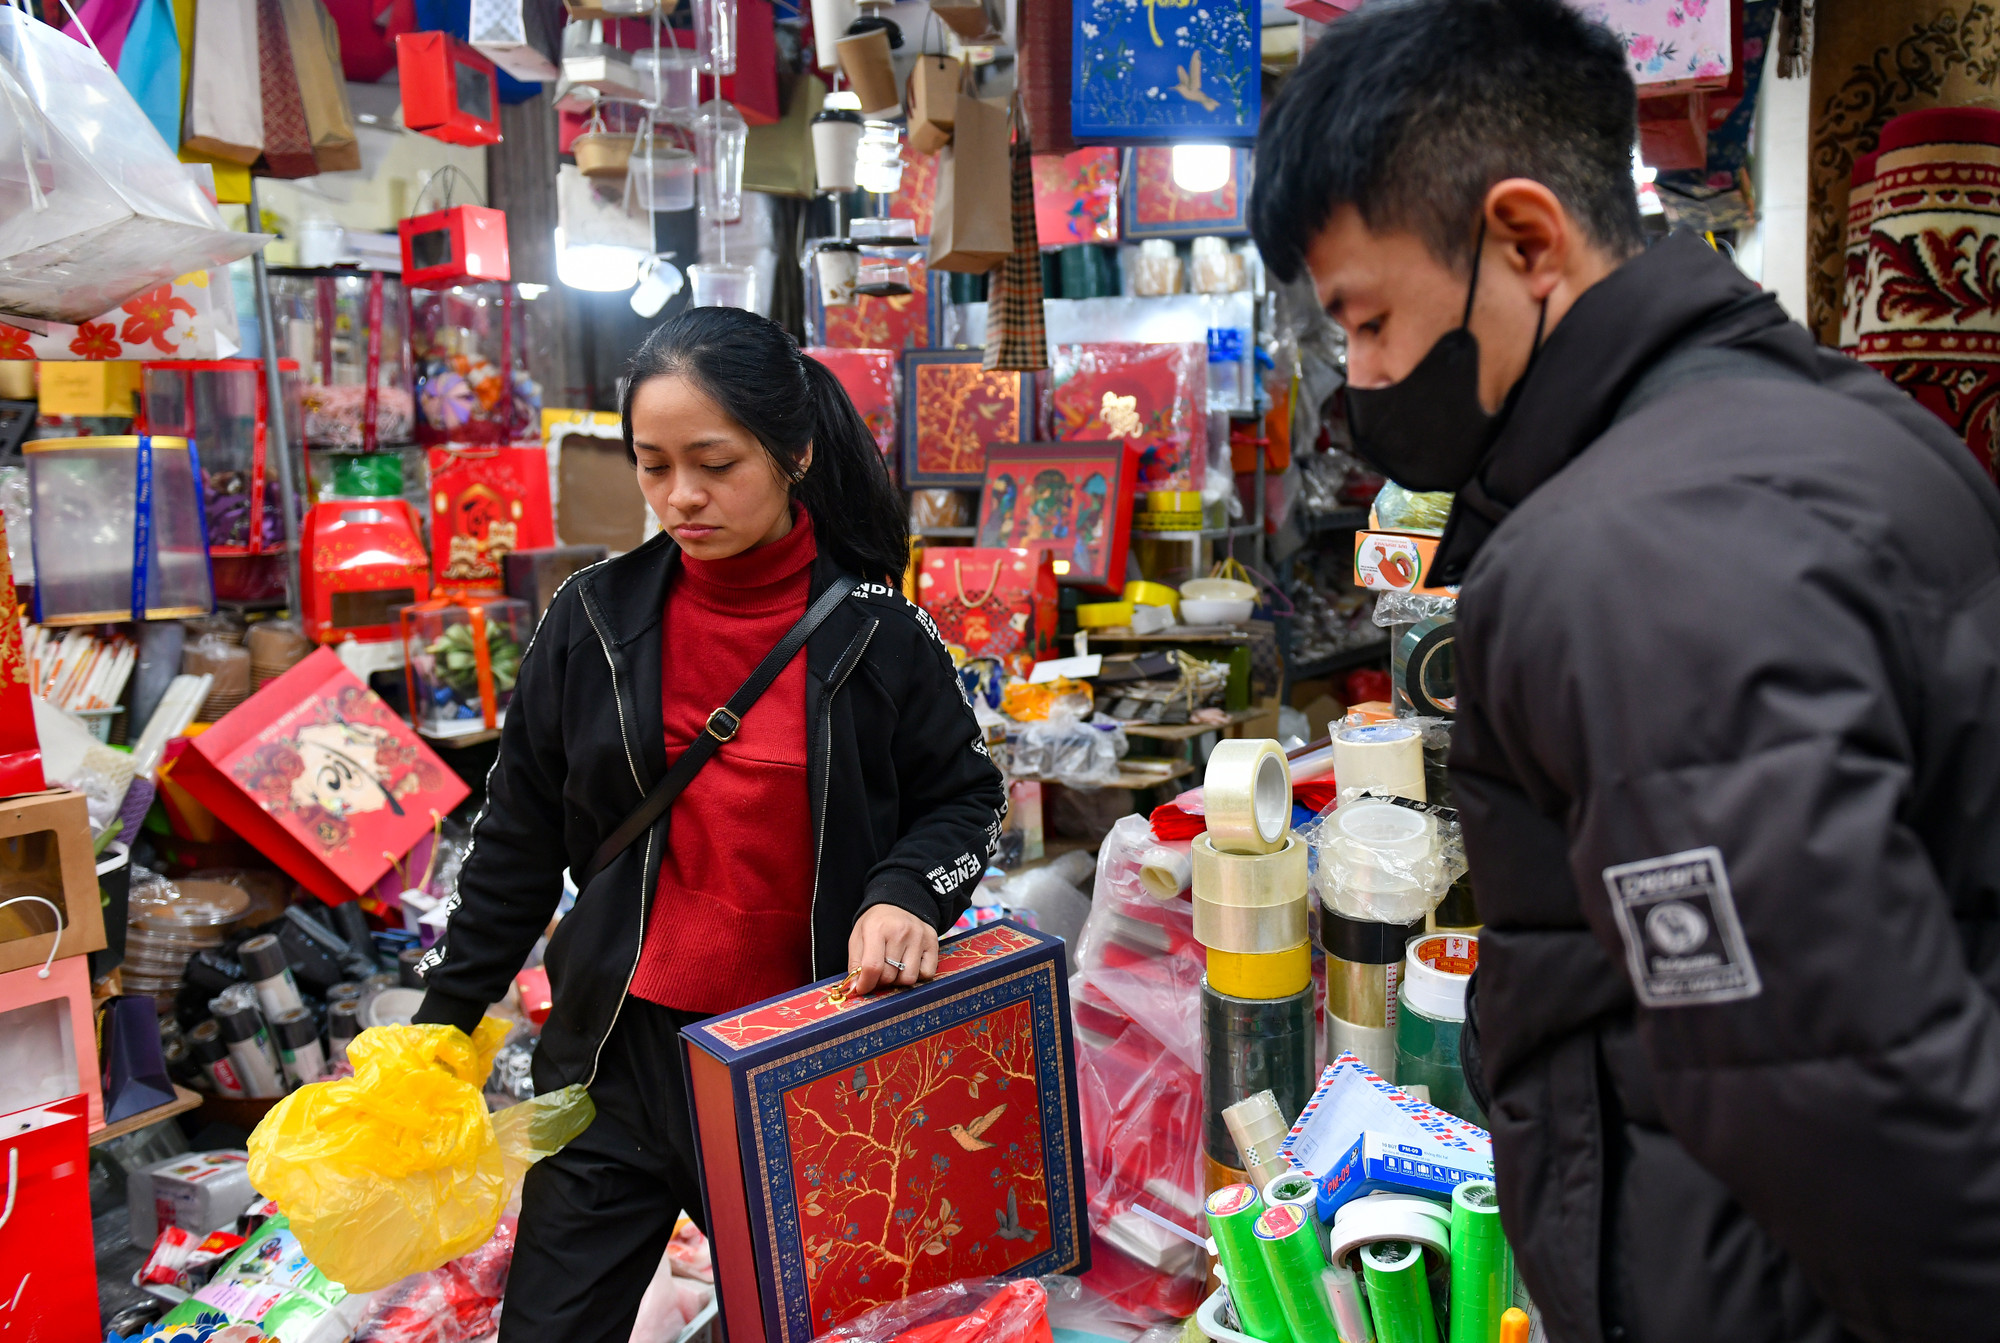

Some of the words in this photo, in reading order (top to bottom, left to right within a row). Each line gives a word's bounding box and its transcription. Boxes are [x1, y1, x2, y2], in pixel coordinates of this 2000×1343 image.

[856, 582, 893, 598] NDI
[1402, 1146, 1419, 1154] PM-09
[1328, 1164, 1350, 1197] PM-09
